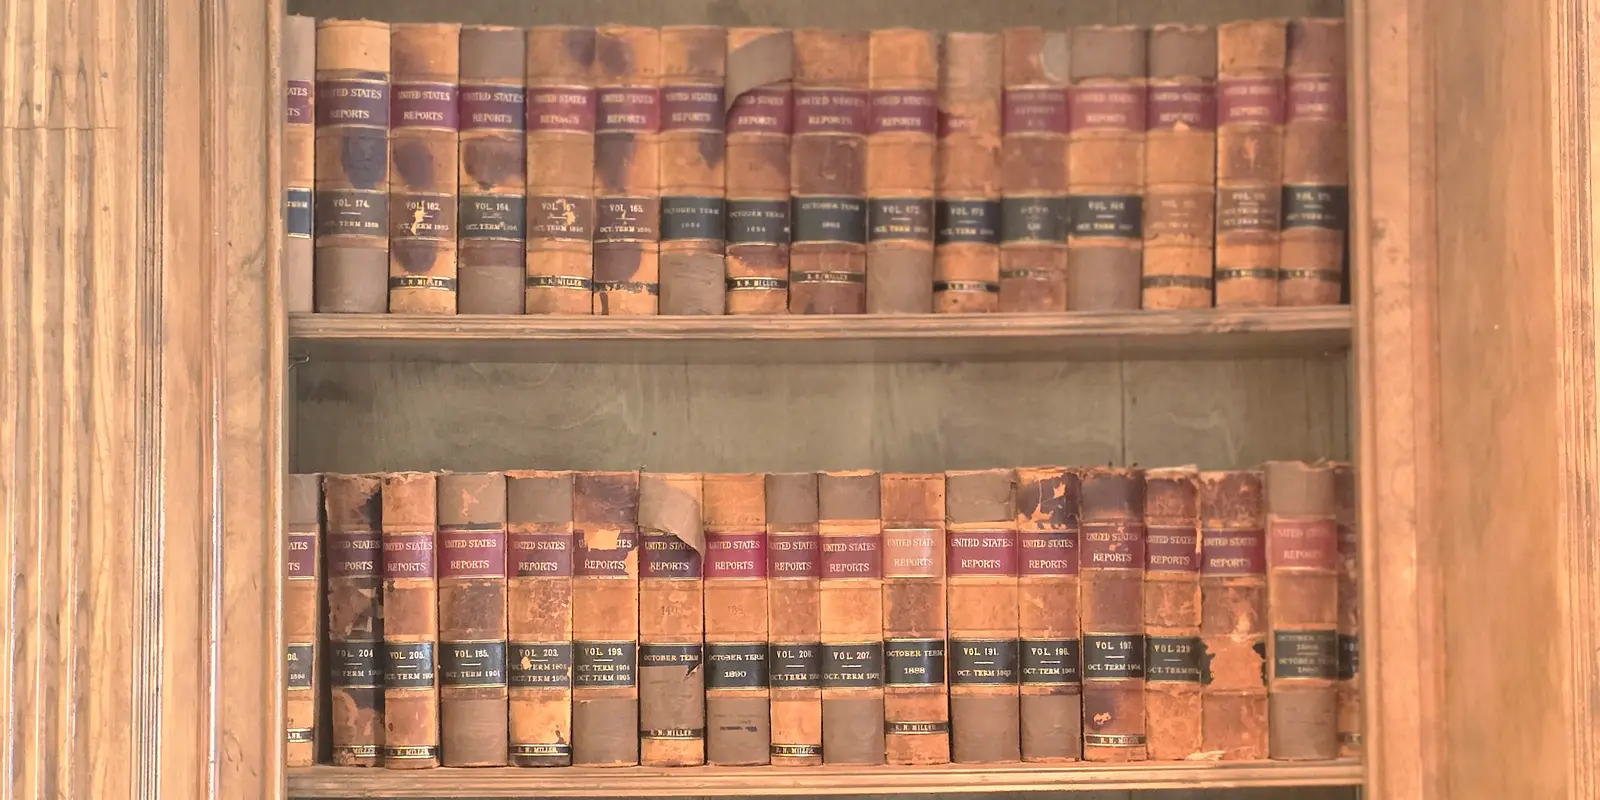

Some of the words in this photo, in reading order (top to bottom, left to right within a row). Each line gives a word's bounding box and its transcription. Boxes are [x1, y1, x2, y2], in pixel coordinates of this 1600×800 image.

[288, 88, 308, 97] ATES
[351, 88, 382, 99] STATES
[423, 91, 450, 101] STATES
[494, 92, 524, 103] STATES
[331, 109, 370, 119] REPORTS
[404, 111, 443, 121] REPORTS
[473, 113, 512, 123] REPORTS
[672, 112, 710, 122] REPORTS
[607, 114, 646, 124] REPORTS
[557, 278, 582, 287] MILLER
[1086, 533, 1110, 541] UNITED
[1146, 536, 1168, 544] UNITED
[288, 542, 308, 550] ATES
[352, 540, 380, 549] STATES
[406, 542, 432, 550] STATES
[444, 540, 466, 548] UNITED
[469, 540, 496, 548] STATES
[538, 541, 565, 550] STATES
[645, 542, 667, 550] UNITED
[708, 541, 732, 549] UNITED
[733, 540, 760, 549] STATES
[792, 542, 817, 550] STATES
[888, 538, 911, 547] UNITED
[952, 538, 979, 547] UNITED
[982, 538, 1013, 547] STATES
[1023, 539, 1046, 548] UNITED
[1048, 540, 1074, 548] STATES
[1204, 538, 1228, 546] UNITED
[1230, 538, 1256, 546] STATES
[823, 544, 846, 552] UNITED
[849, 542, 876, 551] STATES
[1093, 552, 1132, 562] REPORTS
[1150, 556, 1190, 564] REPORTS
[344, 561, 373, 570] PORTS
[388, 562, 426, 572] REPORTS
[450, 560, 489, 569] REPORTS
[518, 562, 558, 570] REPORTS
[584, 559, 625, 570] REPORTS
[650, 561, 690, 570] REPORTS
[715, 562, 754, 570] REPORTS
[774, 562, 812, 570] REPORTS
[894, 558, 933, 567] REPORTS
[962, 559, 1000, 568] REPORTS
[1028, 560, 1068, 568] REPORTS
[1210, 558, 1251, 568] REPORTS
[830, 564, 870, 572] REPORTS
[912, 724, 936, 732] MILLER
[406, 748, 430, 756] MILLER
[534, 746, 558, 754] MILLER
